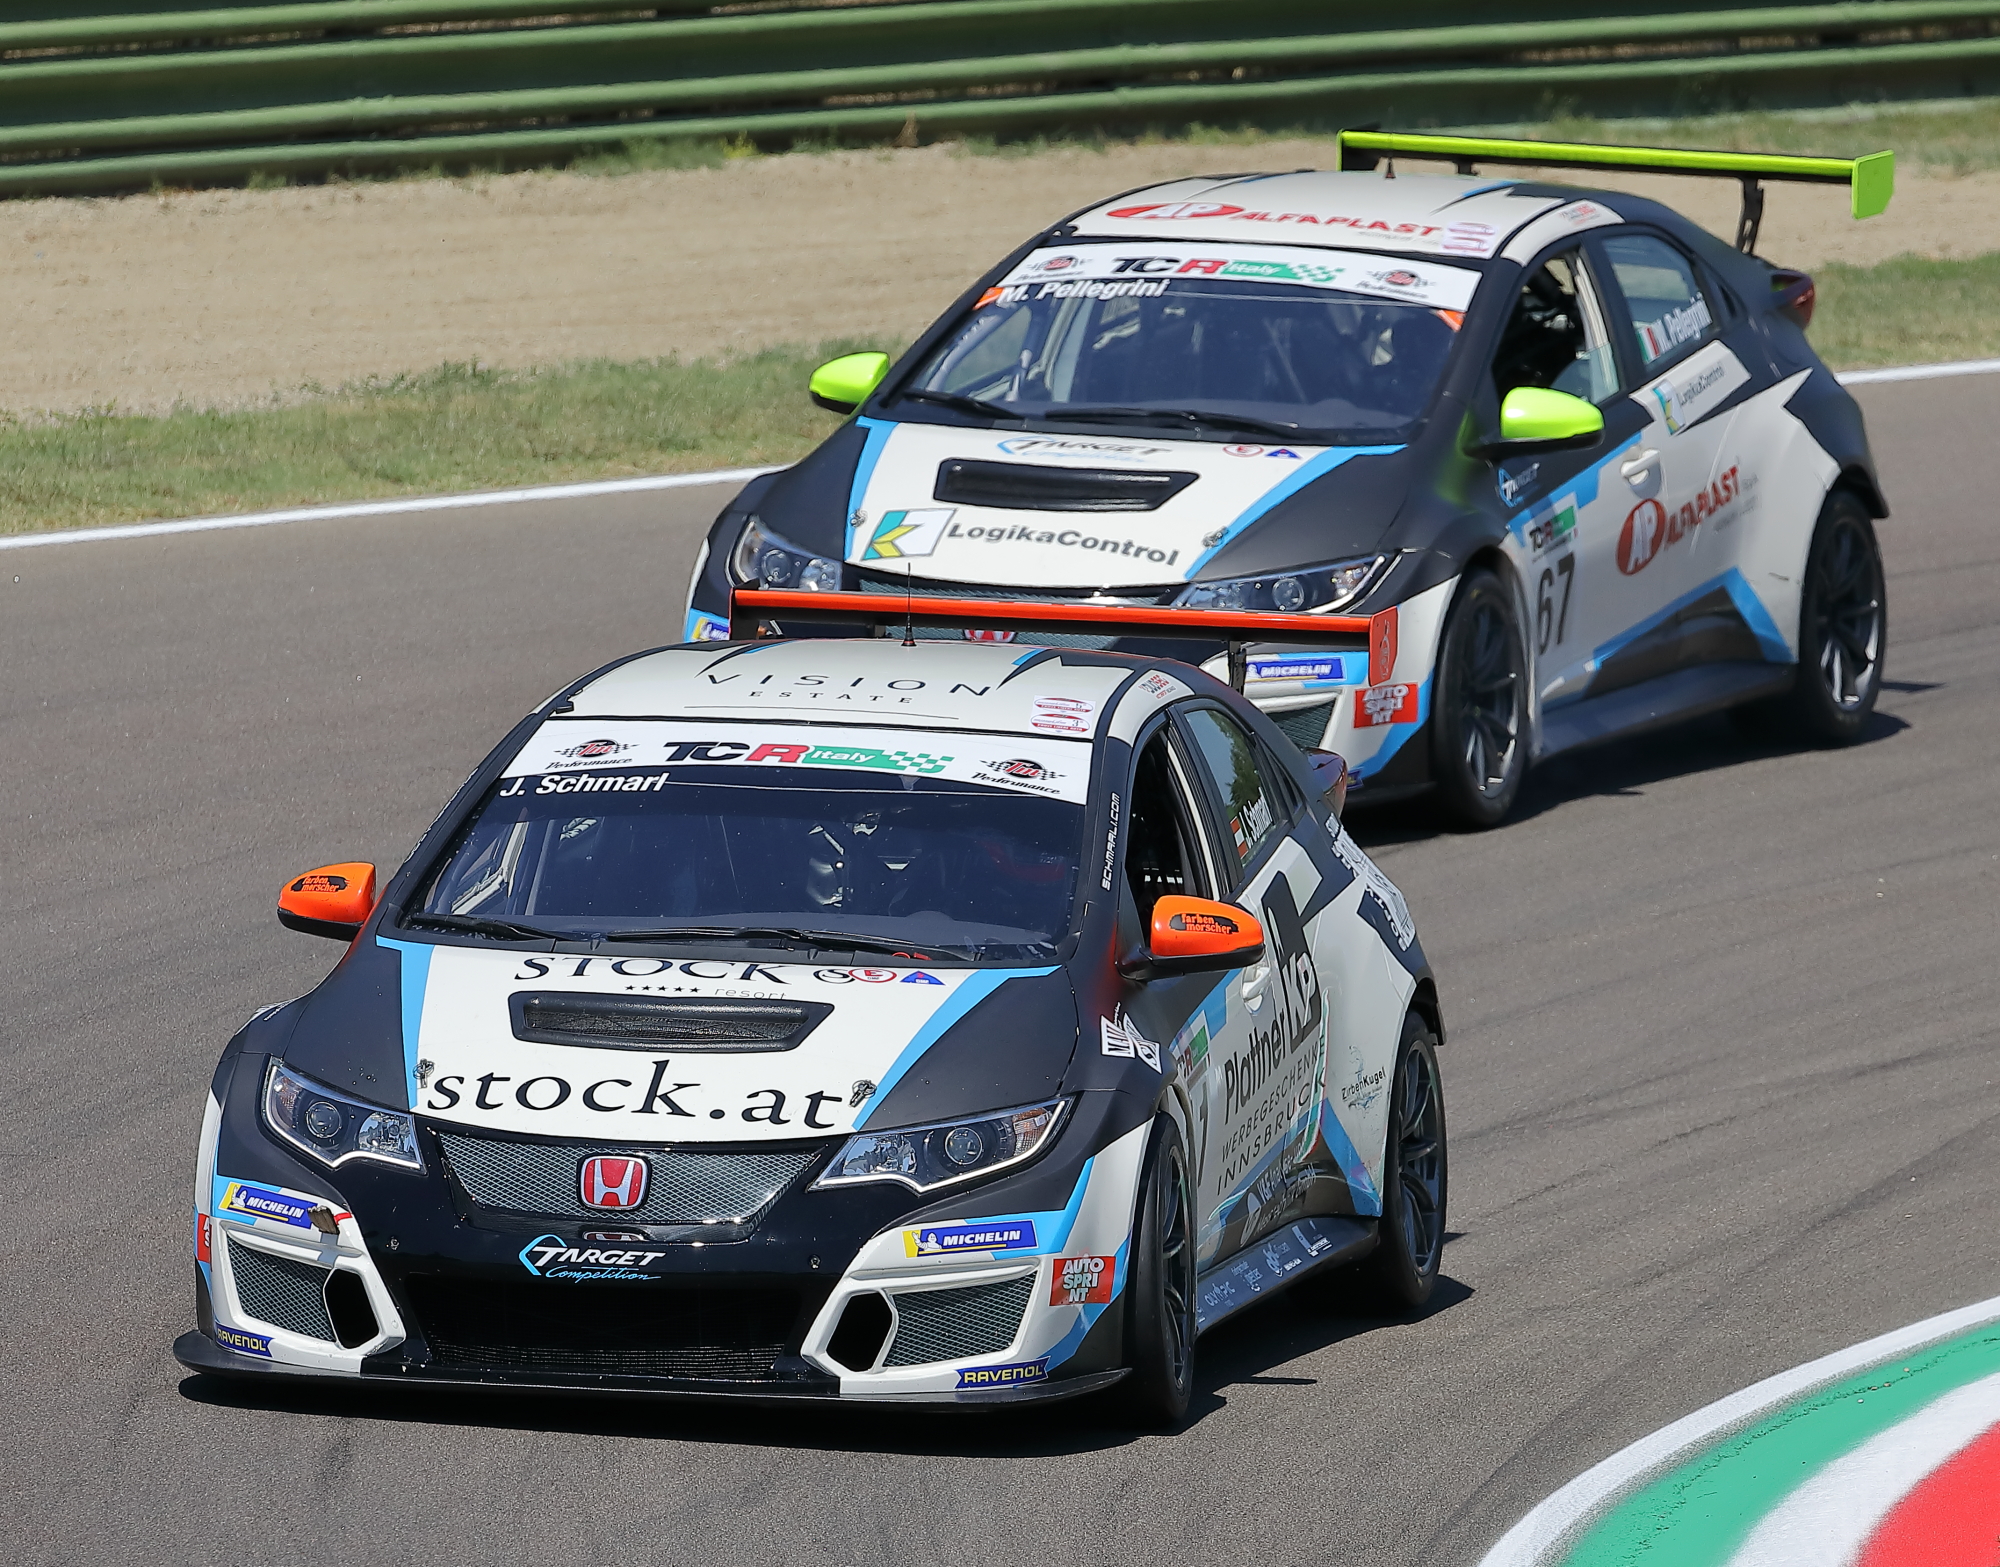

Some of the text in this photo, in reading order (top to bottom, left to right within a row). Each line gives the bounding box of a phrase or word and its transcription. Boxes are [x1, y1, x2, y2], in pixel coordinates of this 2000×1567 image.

[1230, 210, 1443, 237] ALFAPLAST
[1112, 254, 1230, 275] TCR
[999, 279, 1171, 302] M. Pellegrini
[1665, 465, 1740, 549] ALFAPLAST
[948, 523, 1180, 567] LogikaControl
[1538, 552, 1575, 656] 67
[1261, 664, 1332, 677] MICHELIN
[708, 674, 991, 697] VISION
[1363, 685, 1409, 701] AUTO
[749, 691, 912, 703] ESTATE
[1372, 710, 1394, 725] NT
[663, 741, 876, 763] TCR Italy
[545, 758, 633, 770] Performance
[500, 772, 669, 797] J. Schmarl
[971, 772, 1061, 794] Performance
[1102, 792, 1120, 891] SCHMARLI.COM
[1181, 913, 1215, 924] farben
[1186, 923, 1231, 934] morscher
[514, 957, 791, 985] STOCK
[1225, 1010, 1286, 1125] Plattner
[427, 1059, 842, 1129] stock.at
[1342, 1066, 1386, 1100] ZirbenKugel
[1222, 1035, 1325, 1162] WERBEGESCHENKE
[1217, 1068, 1325, 1195] INNSBRUCK
[247, 1197, 304, 1218] MICHELIN
[943, 1230, 1020, 1246] MICHELIN
[532, 1246, 666, 1267] TARGET
[1062, 1258, 1104, 1274] AUTO
[546, 1265, 661, 1283] Competition
[1063, 1273, 1098, 1289] SPRI
[1069, 1288, 1088, 1302] NT
[217, 1328, 266, 1351] RAVENOL
[964, 1365, 1042, 1383] RAVENOL
